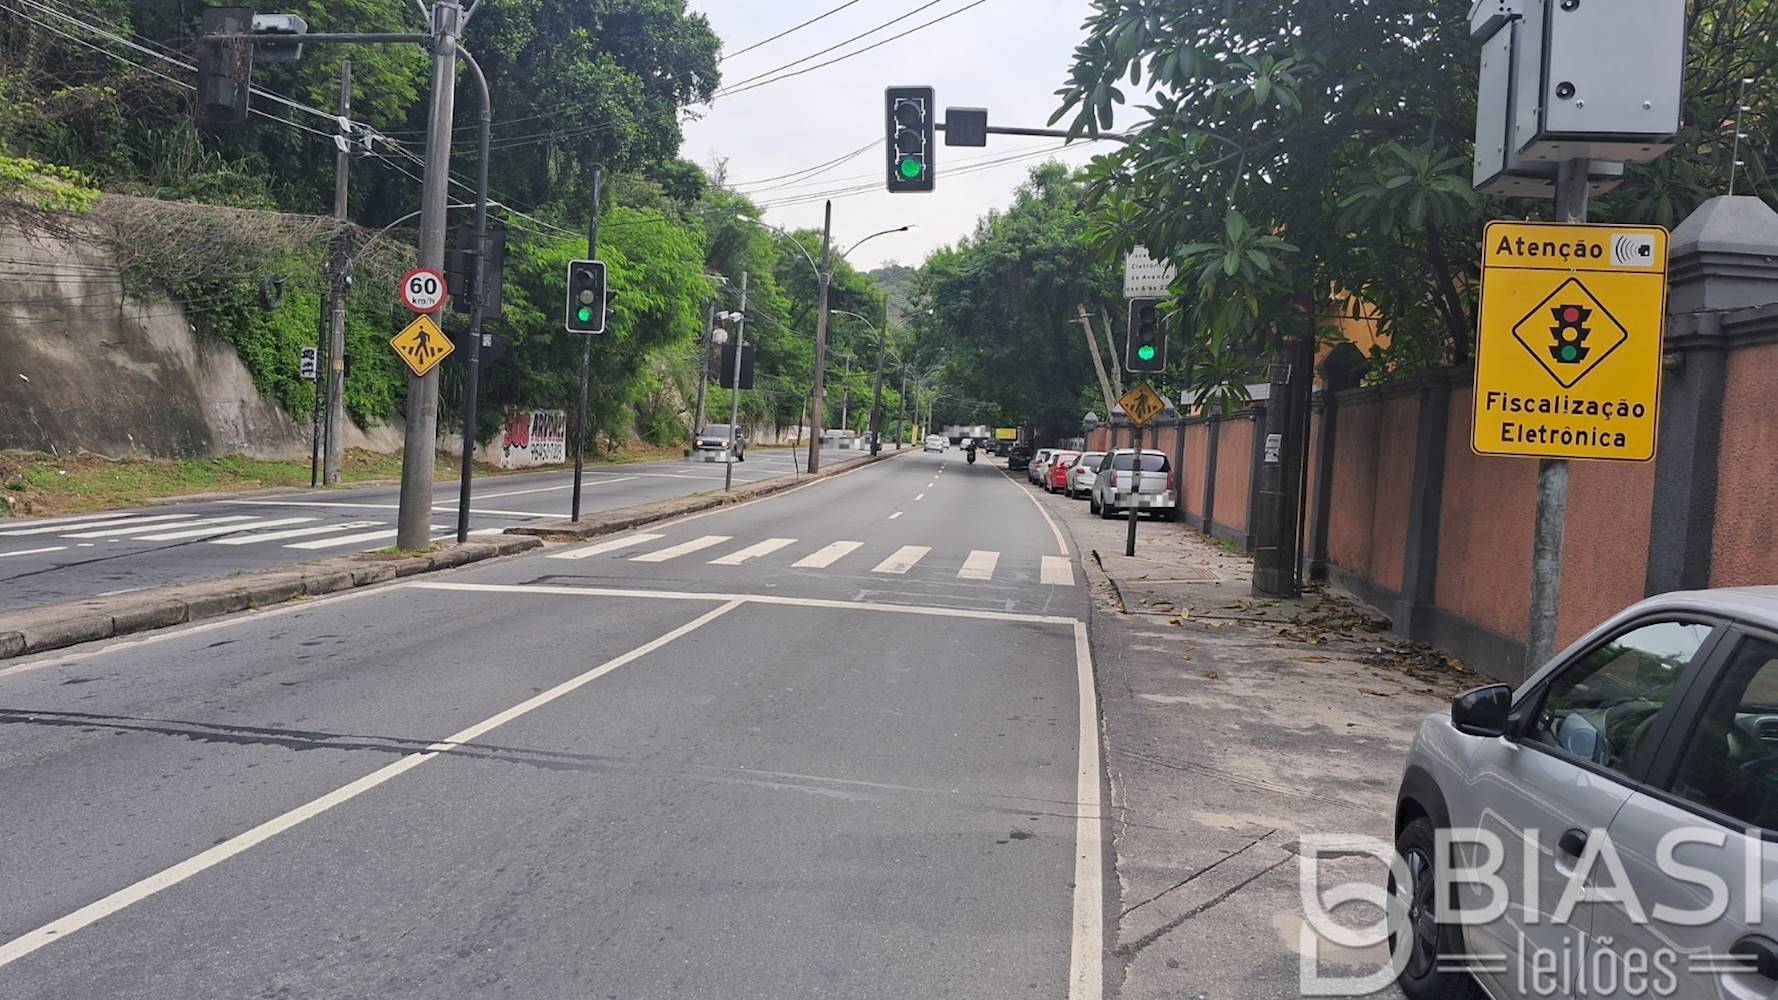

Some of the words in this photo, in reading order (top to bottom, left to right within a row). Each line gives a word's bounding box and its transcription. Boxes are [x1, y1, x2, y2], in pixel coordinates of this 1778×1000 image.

[1496, 235, 1604, 262] Atenção
[410, 277, 437, 295] 60
[411, 296, 436, 305] km/h
[1486, 391, 1646, 421] Fiscalização
[1500, 422, 1626, 448] Eletrônica
